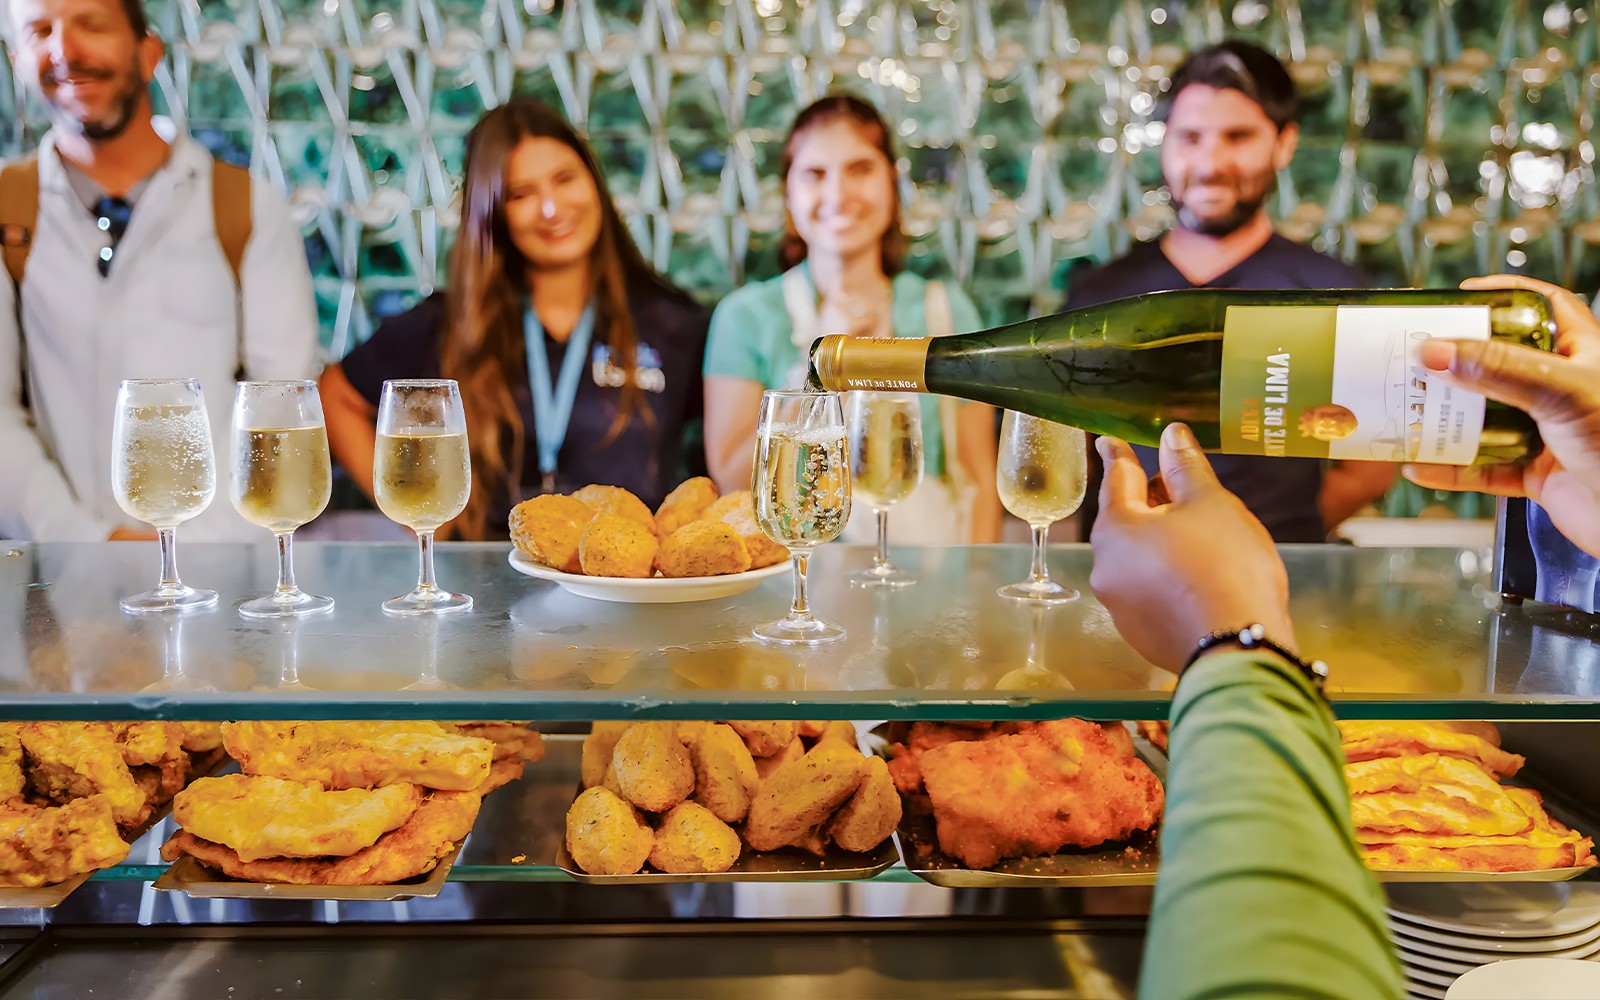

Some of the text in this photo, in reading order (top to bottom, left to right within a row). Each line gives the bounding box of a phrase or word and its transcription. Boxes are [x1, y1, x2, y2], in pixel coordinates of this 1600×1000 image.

[848, 379, 872, 387] LIMA
[886, 380, 918, 388] PONTE
[1264, 353, 1290, 457] NTE DE LIMA
